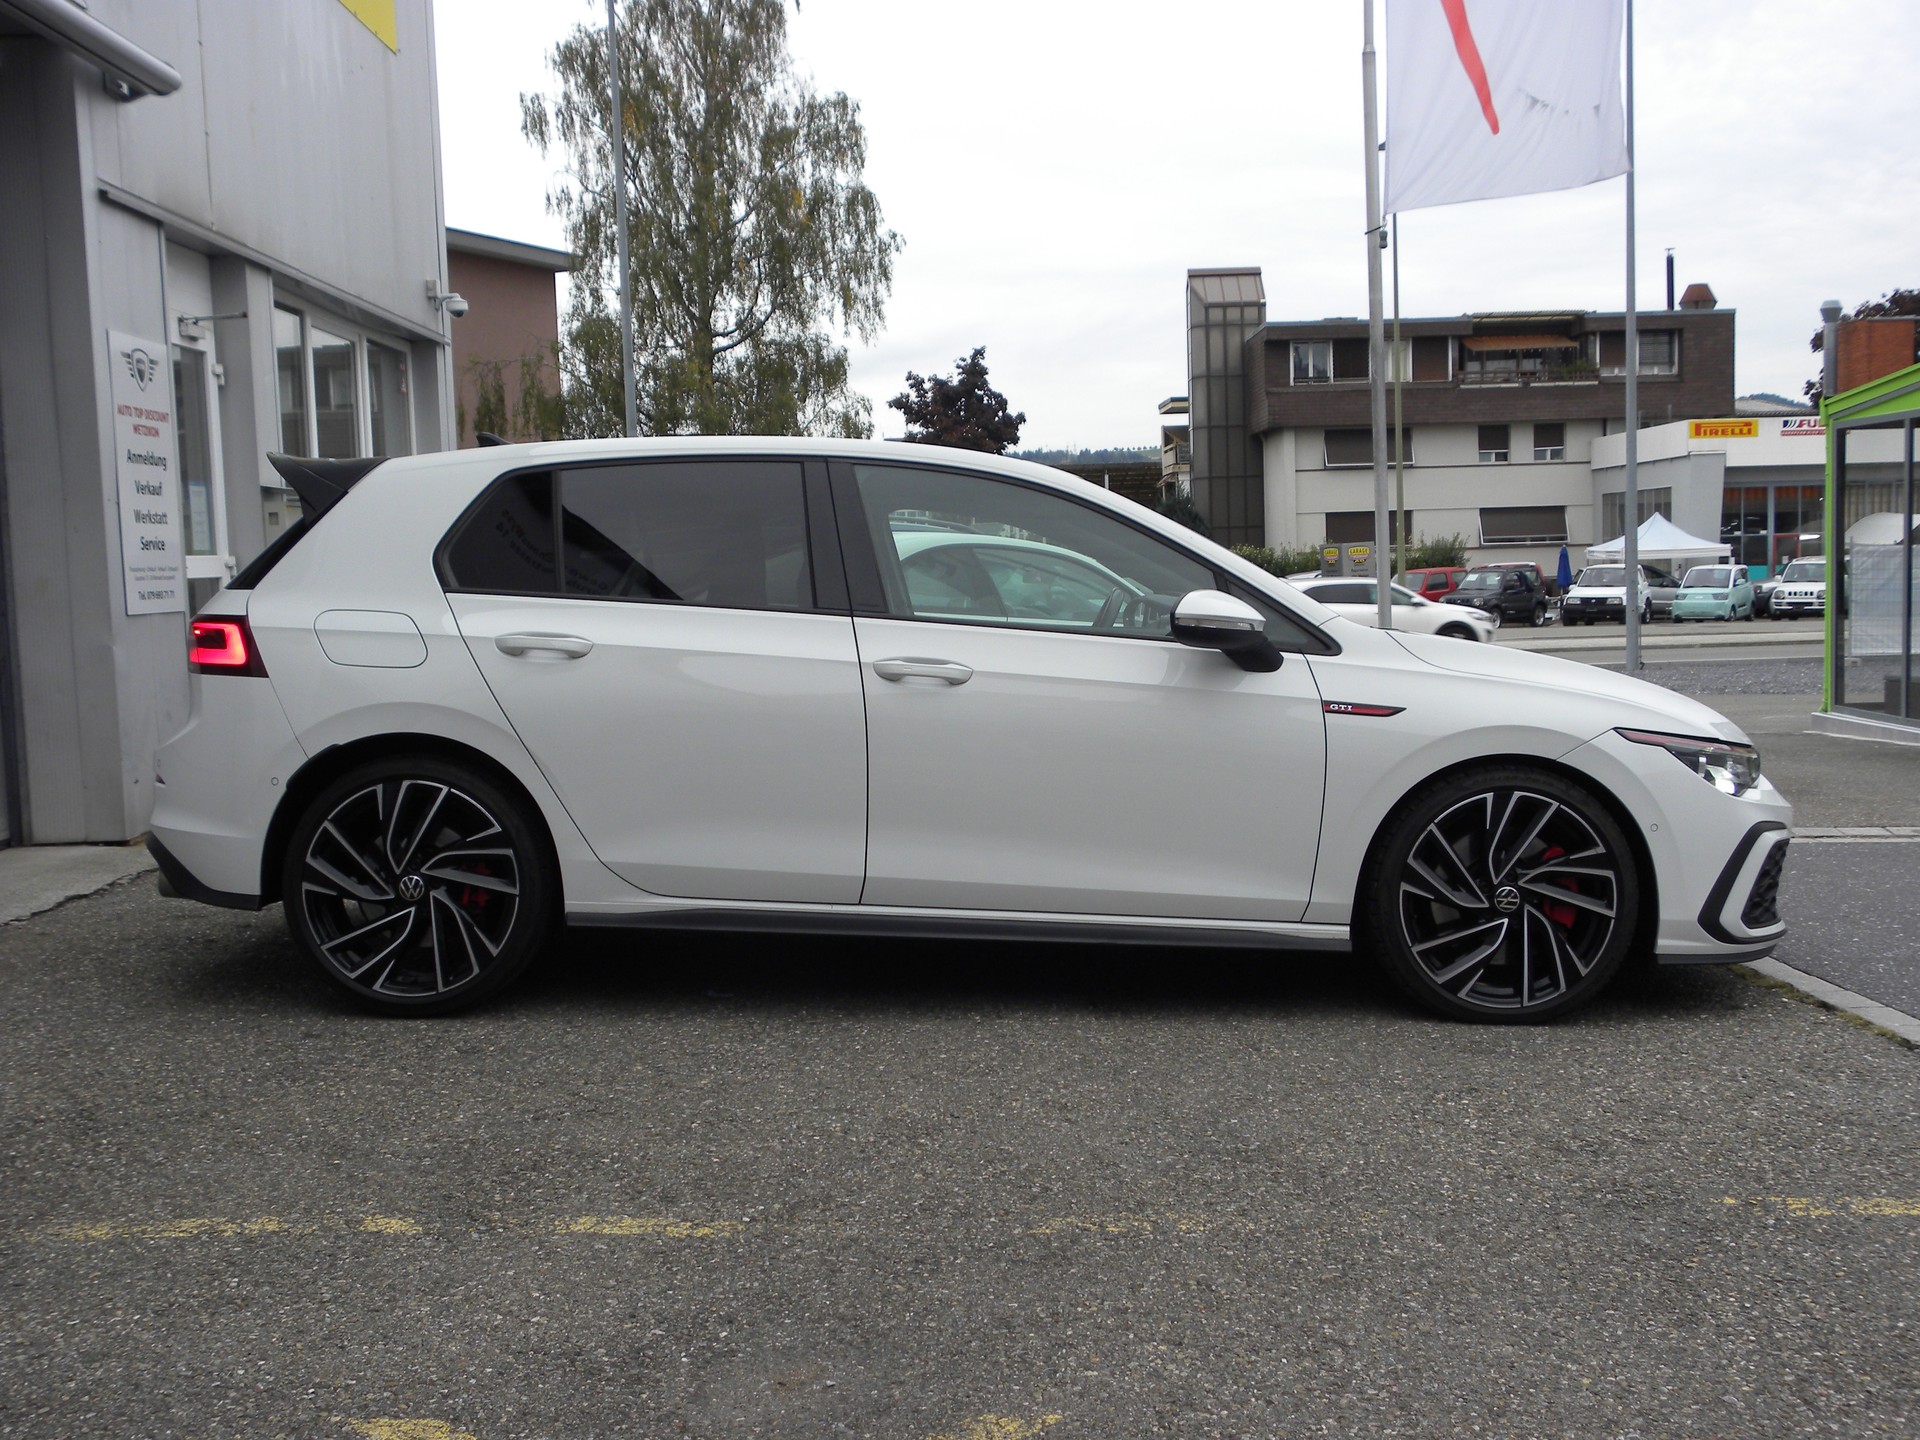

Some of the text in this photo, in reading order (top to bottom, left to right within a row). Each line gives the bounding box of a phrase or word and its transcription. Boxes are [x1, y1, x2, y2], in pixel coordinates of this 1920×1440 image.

[117, 405, 169, 424] AUTO TOP DISCOUNT
[1694, 421, 1753, 436] PIRELLI
[127, 449, 167, 472] Anmeldung
[134, 480, 162, 496] Verkauf
[133, 509, 168, 525] Werkstatt
[140, 536, 165, 551] Service
